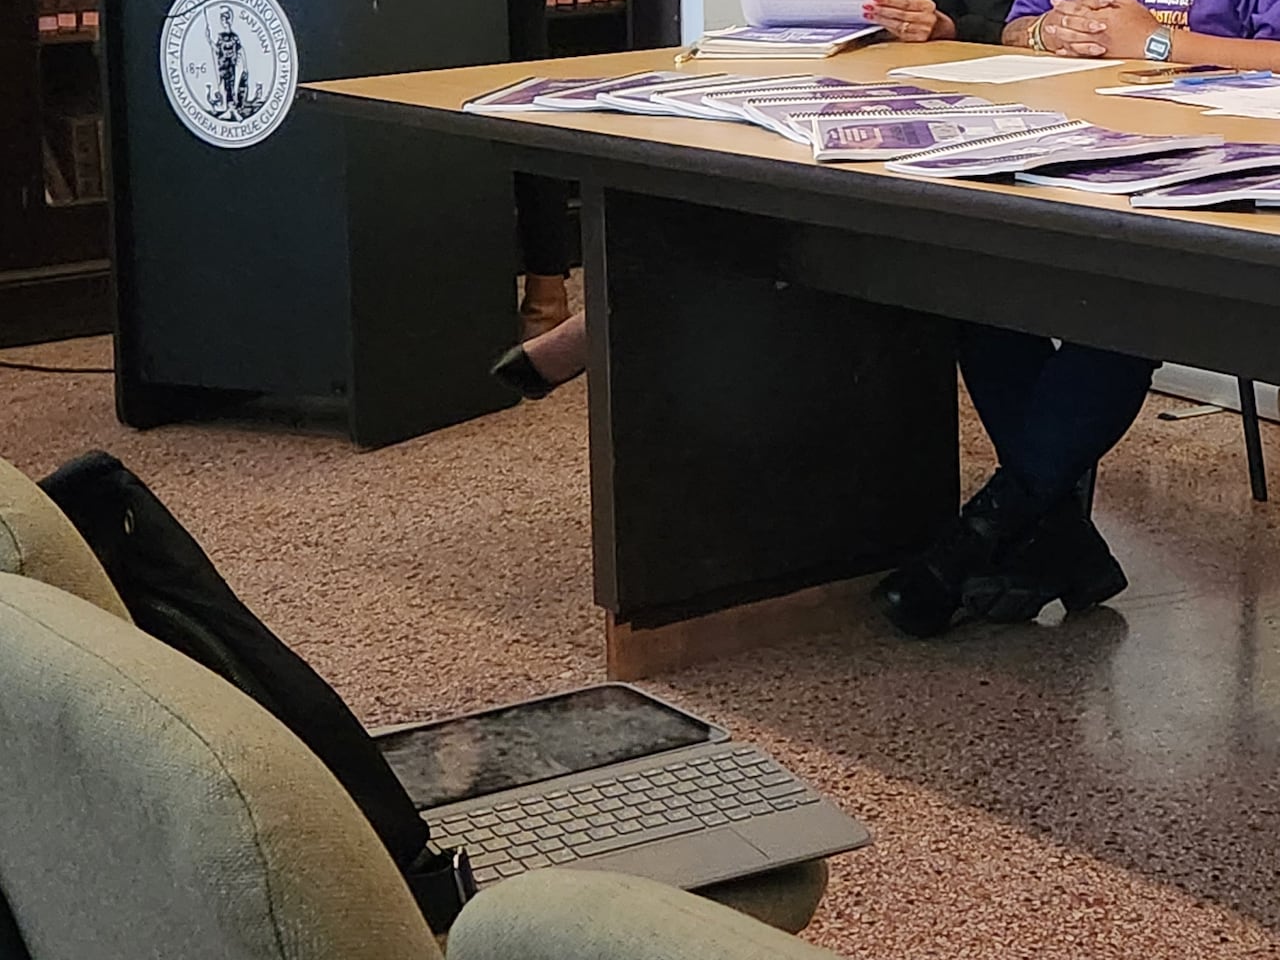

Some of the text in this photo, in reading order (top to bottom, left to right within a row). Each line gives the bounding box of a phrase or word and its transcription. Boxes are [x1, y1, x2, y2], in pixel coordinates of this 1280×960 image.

[238, 10, 271, 54] SAN JUAN
[174, 83, 218, 135] MAJOREM
[260, 68, 290, 125] GLORIAM
